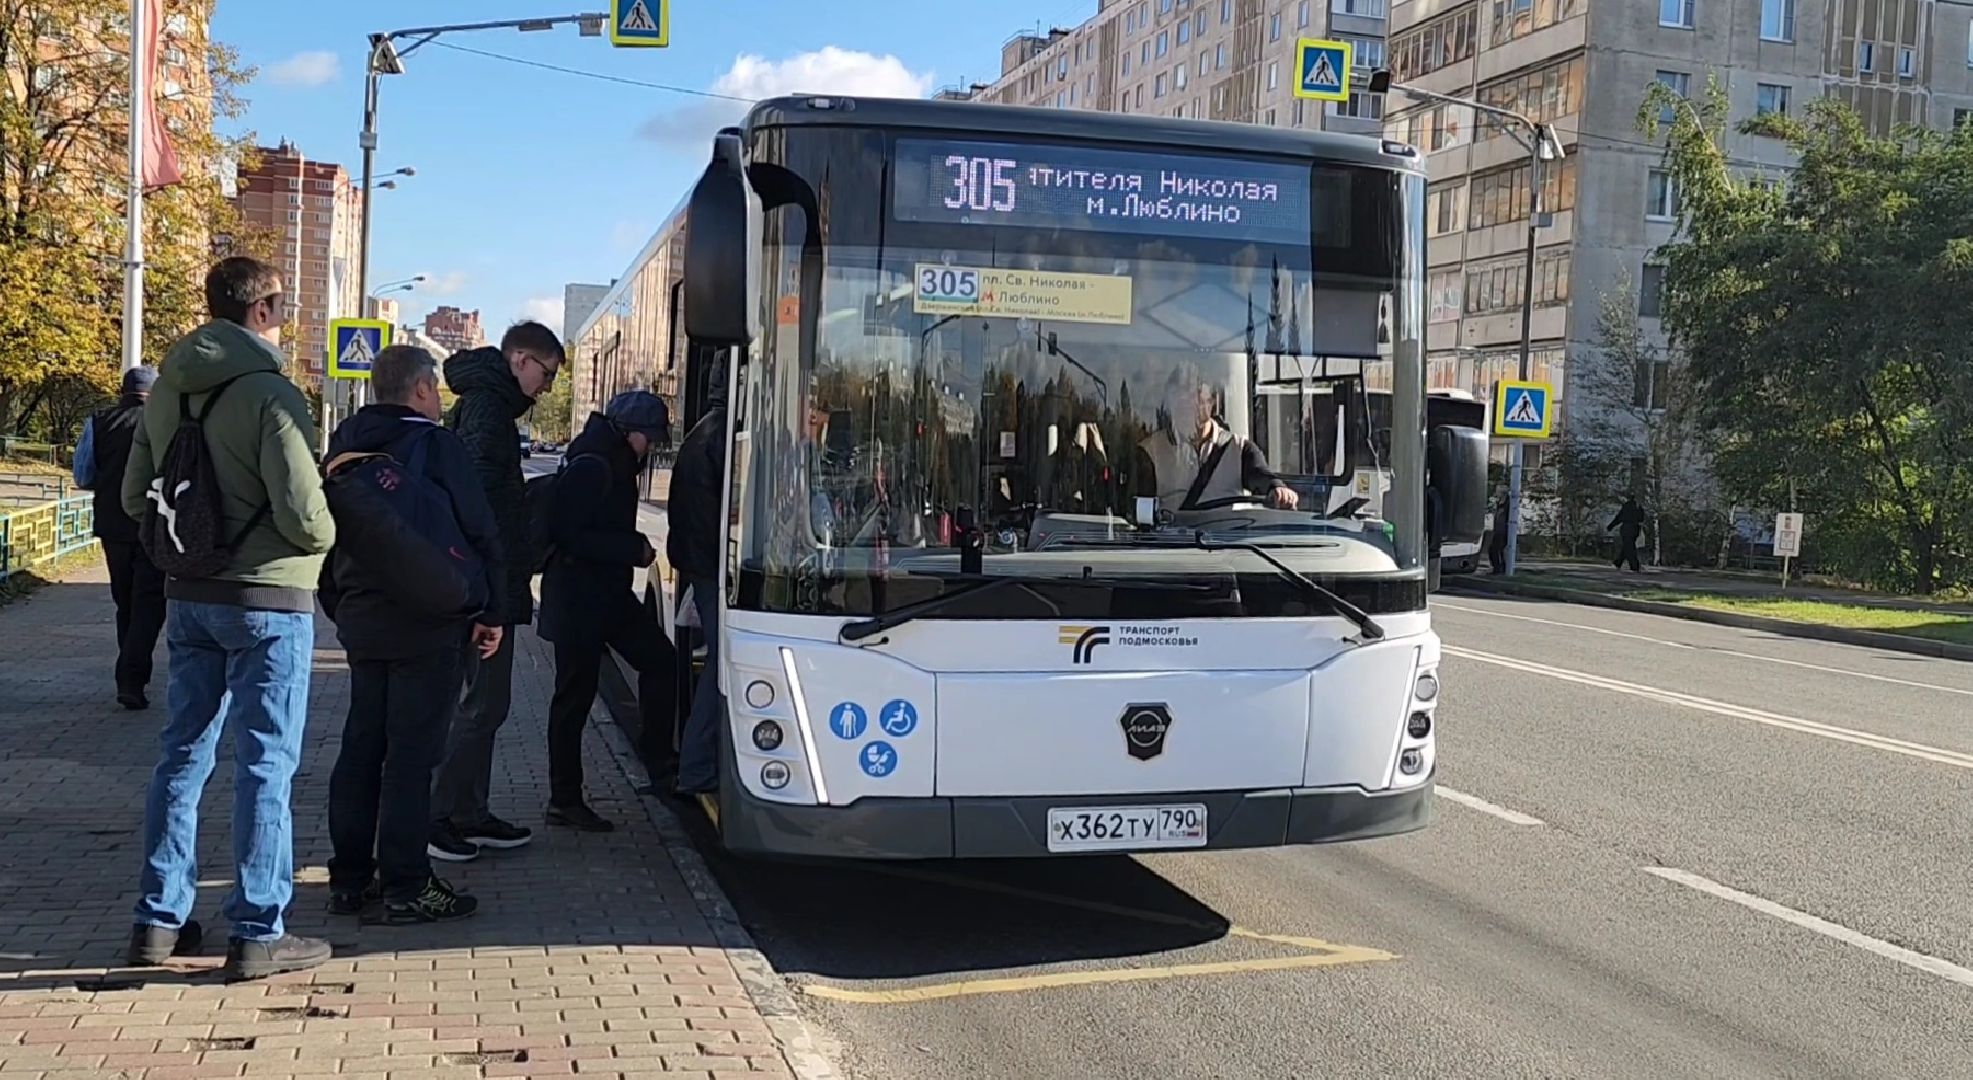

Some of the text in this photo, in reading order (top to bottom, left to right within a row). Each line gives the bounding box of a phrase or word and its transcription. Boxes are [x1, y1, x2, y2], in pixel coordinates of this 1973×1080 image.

[945, 156, 1016, 211] 305
[1160, 170, 1277, 201] Николая
[1087, 193, 1240, 222] м.Люблино
[921, 269, 975, 296] 305
[1029, 276, 1086, 290] Николая
[999, 291, 1060, 305] Люблино
[1119, 626, 1180, 635] ТРАНСПОРТ
[1119, 637, 1198, 646] ПОДМОСКОВЬЯ
[1161, 809, 1197, 830] 790
